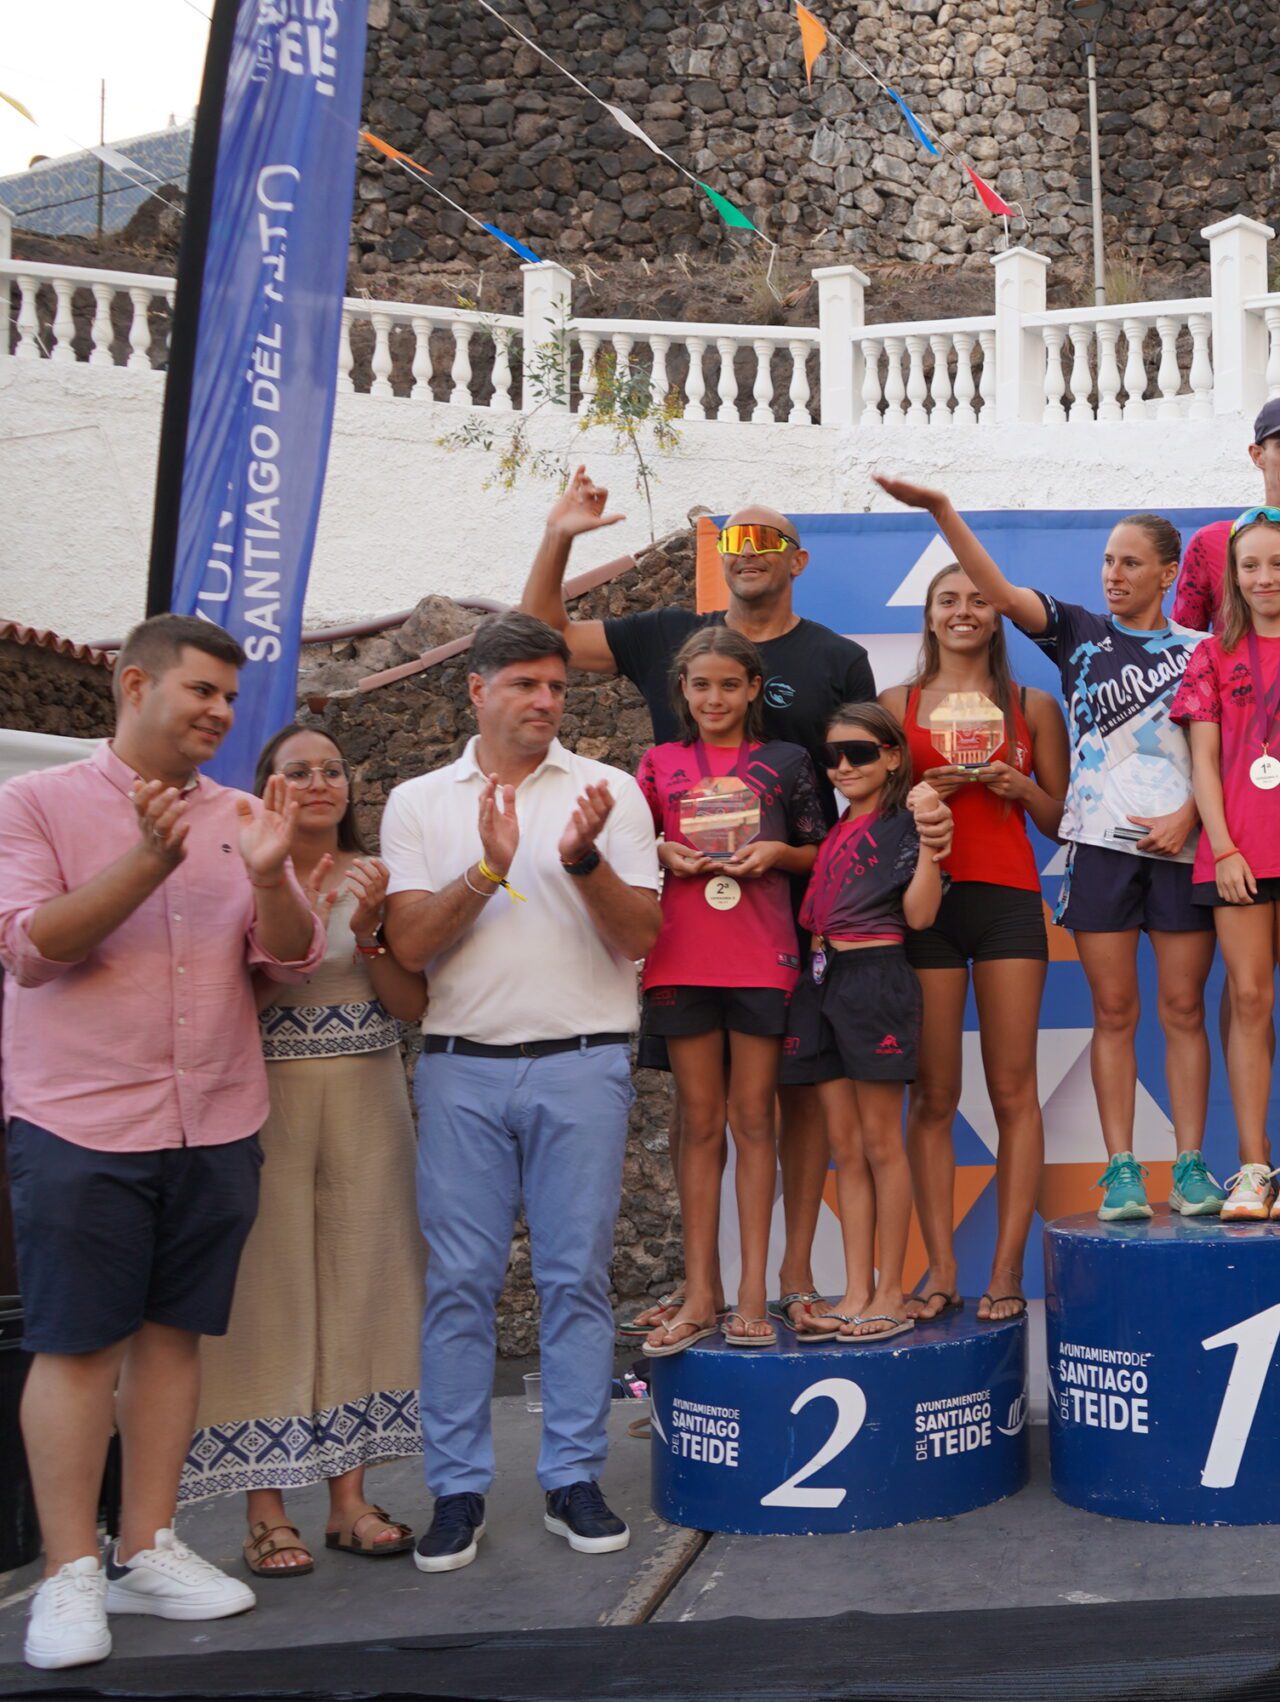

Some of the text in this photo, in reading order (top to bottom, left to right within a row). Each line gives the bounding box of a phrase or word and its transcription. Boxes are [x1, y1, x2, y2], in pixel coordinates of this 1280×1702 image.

[251, 323, 282, 412] DEL
[244, 424, 281, 662] SANTIAGO
[1059, 1359, 1148, 1394] SANTIAGO
[672, 1410, 740, 1438] SANTIAGO
[915, 1402, 991, 1433] SANTIAGO
[1060, 1387, 1149, 1434] DEL TEIDE
[671, 1431, 739, 1467] DEL TEIDE
[760, 1377, 867, 1508] 2
[916, 1421, 992, 1461] DEL TEIDE
